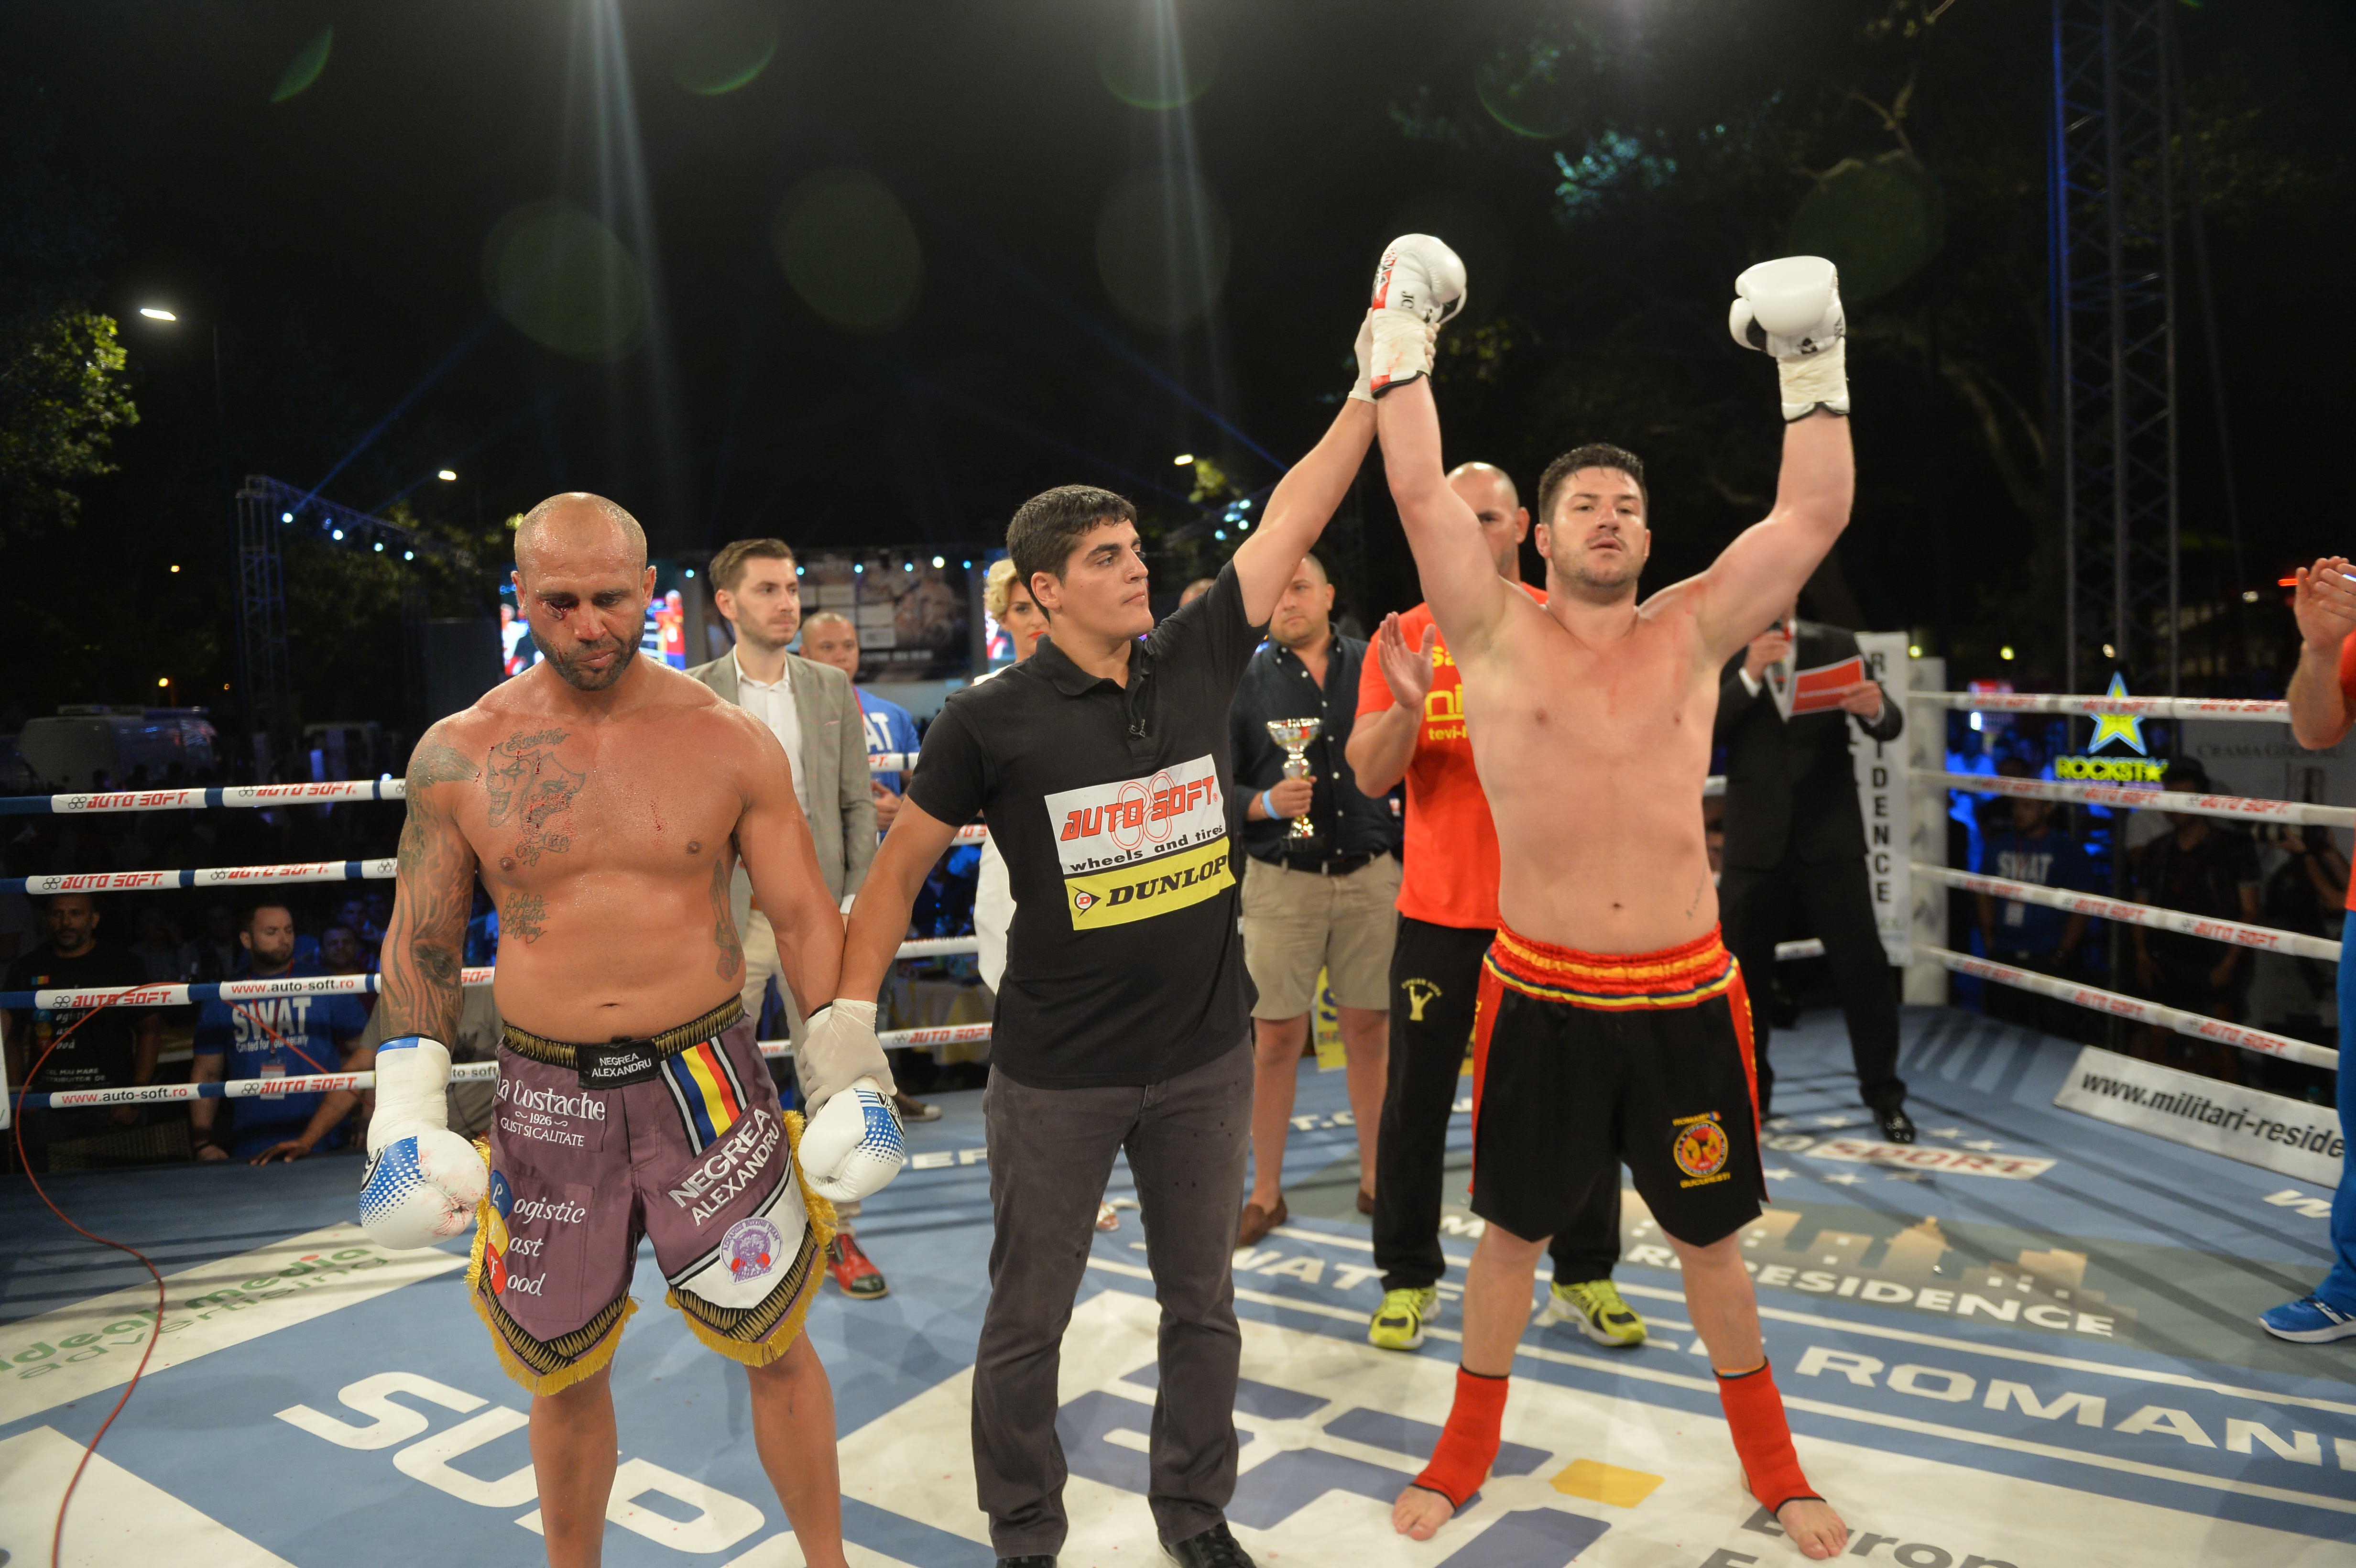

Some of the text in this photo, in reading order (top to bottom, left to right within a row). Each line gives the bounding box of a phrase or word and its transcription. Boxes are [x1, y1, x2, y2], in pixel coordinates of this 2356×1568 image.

[87, 792, 189, 809] AUTO SOFT
[1060, 775, 1214, 841] AUTO SOFT
[1069, 825, 1222, 872] wheels and tires
[60, 873, 163, 889] AUTO SOFT
[1106, 855, 1227, 907] DUNLOP
[461, 970, 493, 983] SOF
[231, 980, 354, 994] www.auto-soft.ro
[71, 991, 171, 1007] AUTO SOFT
[232, 996, 312, 1043] SWAT
[909, 1030, 950, 1044] AUTO
[591, 1058, 652, 1078] ALEXANDRU
[599, 1053, 639, 1067] NEGREA
[260, 1077, 357, 1094] AUTO SOFT
[62, 1088, 187, 1104] www.auto-soft.ro
[513, 1079, 606, 1121] Costache
[529, 1112, 552, 1126] 1926
[2081, 1071, 2344, 1158] www.militari-reside
[501, 1117, 524, 1134] GUST
[532, 1128, 585, 1147] CALITATE
[668, 1108, 771, 1208] NEGREA
[691, 1121, 780, 1227] ALEXANDRU
[1746, 1263, 2115, 1337] ESIDENCE
